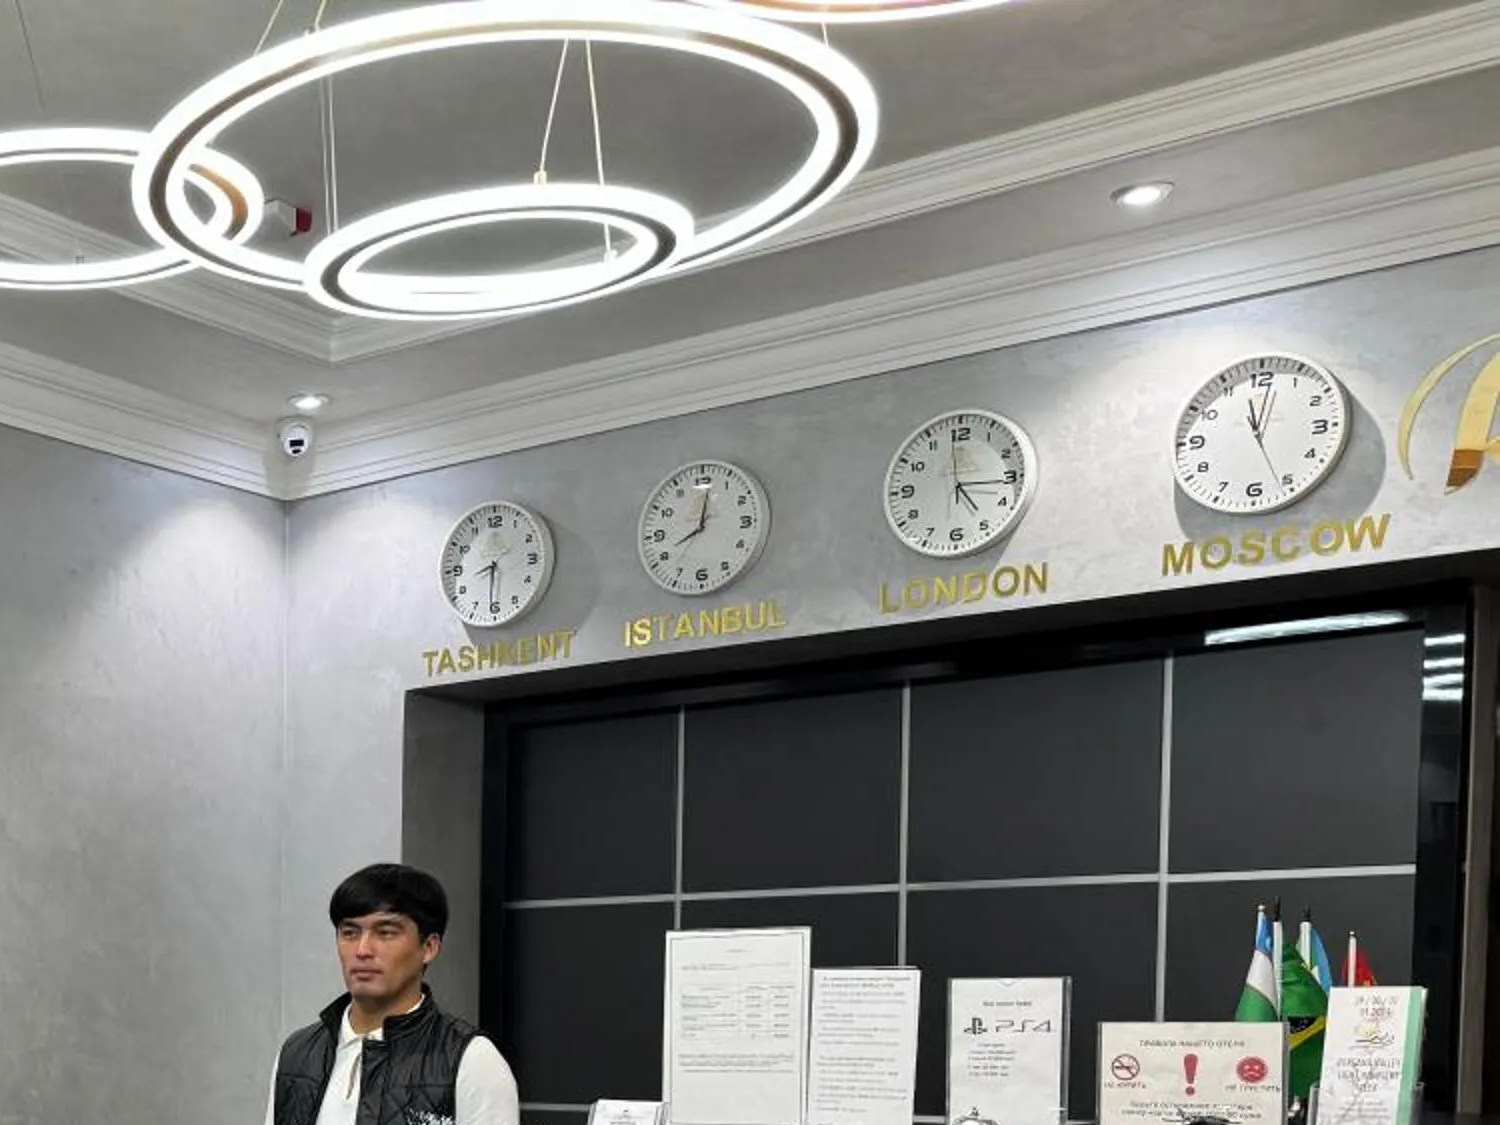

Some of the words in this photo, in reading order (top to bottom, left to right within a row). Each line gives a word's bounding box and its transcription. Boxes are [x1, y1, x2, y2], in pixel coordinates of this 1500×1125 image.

[1251, 371, 1274, 388] 12
[1224, 387, 1233, 396] 11
[1310, 396, 1321, 406] 2
[1202, 409, 1218, 420] 10
[1311, 420, 1328, 435] 3
[952, 428, 970, 442] 12
[930, 441, 937, 450] 11
[1189, 435, 1205, 450] 9
[1001, 449, 1011, 459] 2
[1304, 448, 1316, 459] 4
[911, 462, 924, 472] 10
[1198, 462, 1209, 472] 8
[1004, 470, 1016, 484] 3
[1282, 474, 1293, 485] 5
[901, 485, 914, 498] 9
[1219, 482, 1228, 492] 7
[1246, 483, 1262, 496] 6
[738, 496, 746, 505] 2
[998, 497, 1007, 506] 4
[661, 508, 673, 518] 10
[908, 510, 918, 519] 8
[488, 516, 502, 528] 12
[740, 516, 751, 528] 3
[980, 520, 988, 530] 5
[654, 530, 665, 542] 9
[926, 528, 934, 537] 7
[950, 528, 964, 541] 6
[526, 534, 532, 543] 2
[1161, 513, 1391, 576] MOSCOW
[528, 553, 537, 564] 3
[453, 566, 462, 576] 9
[677, 568, 683, 577] 7
[696, 568, 708, 581] 6
[879, 562, 1048, 615] LONDON
[472, 602, 478, 610] 7
[490, 602, 500, 613] 6
[624, 600, 786, 647] ISTANBUL
[422, 630, 575, 677] TASHKENT
[995, 1019, 1051, 1032] PS4
